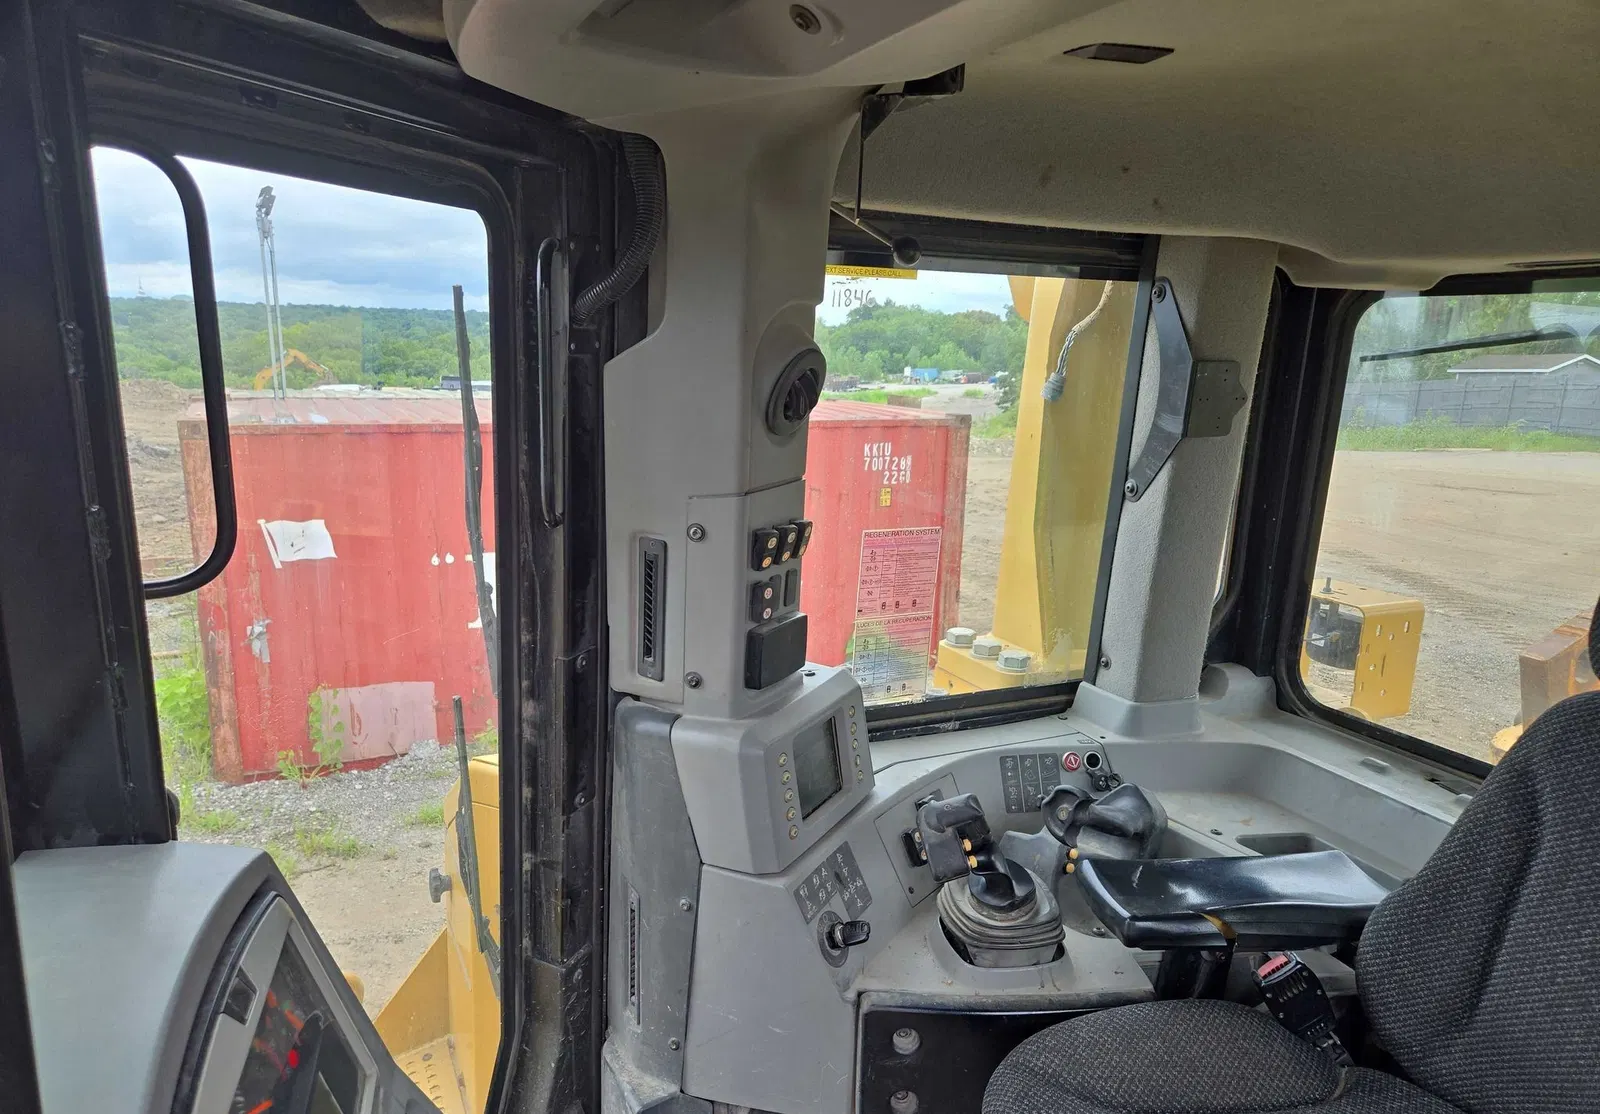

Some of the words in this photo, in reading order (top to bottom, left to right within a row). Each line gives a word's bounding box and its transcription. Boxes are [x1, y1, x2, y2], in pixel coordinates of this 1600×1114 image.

[838, 267, 864, 275] SERVICE
[865, 268, 887, 276] PLEASE
[831, 288, 877, 308] 11846
[864, 442, 891, 457] KKTU
[864, 530, 914, 538] REGENERATION
